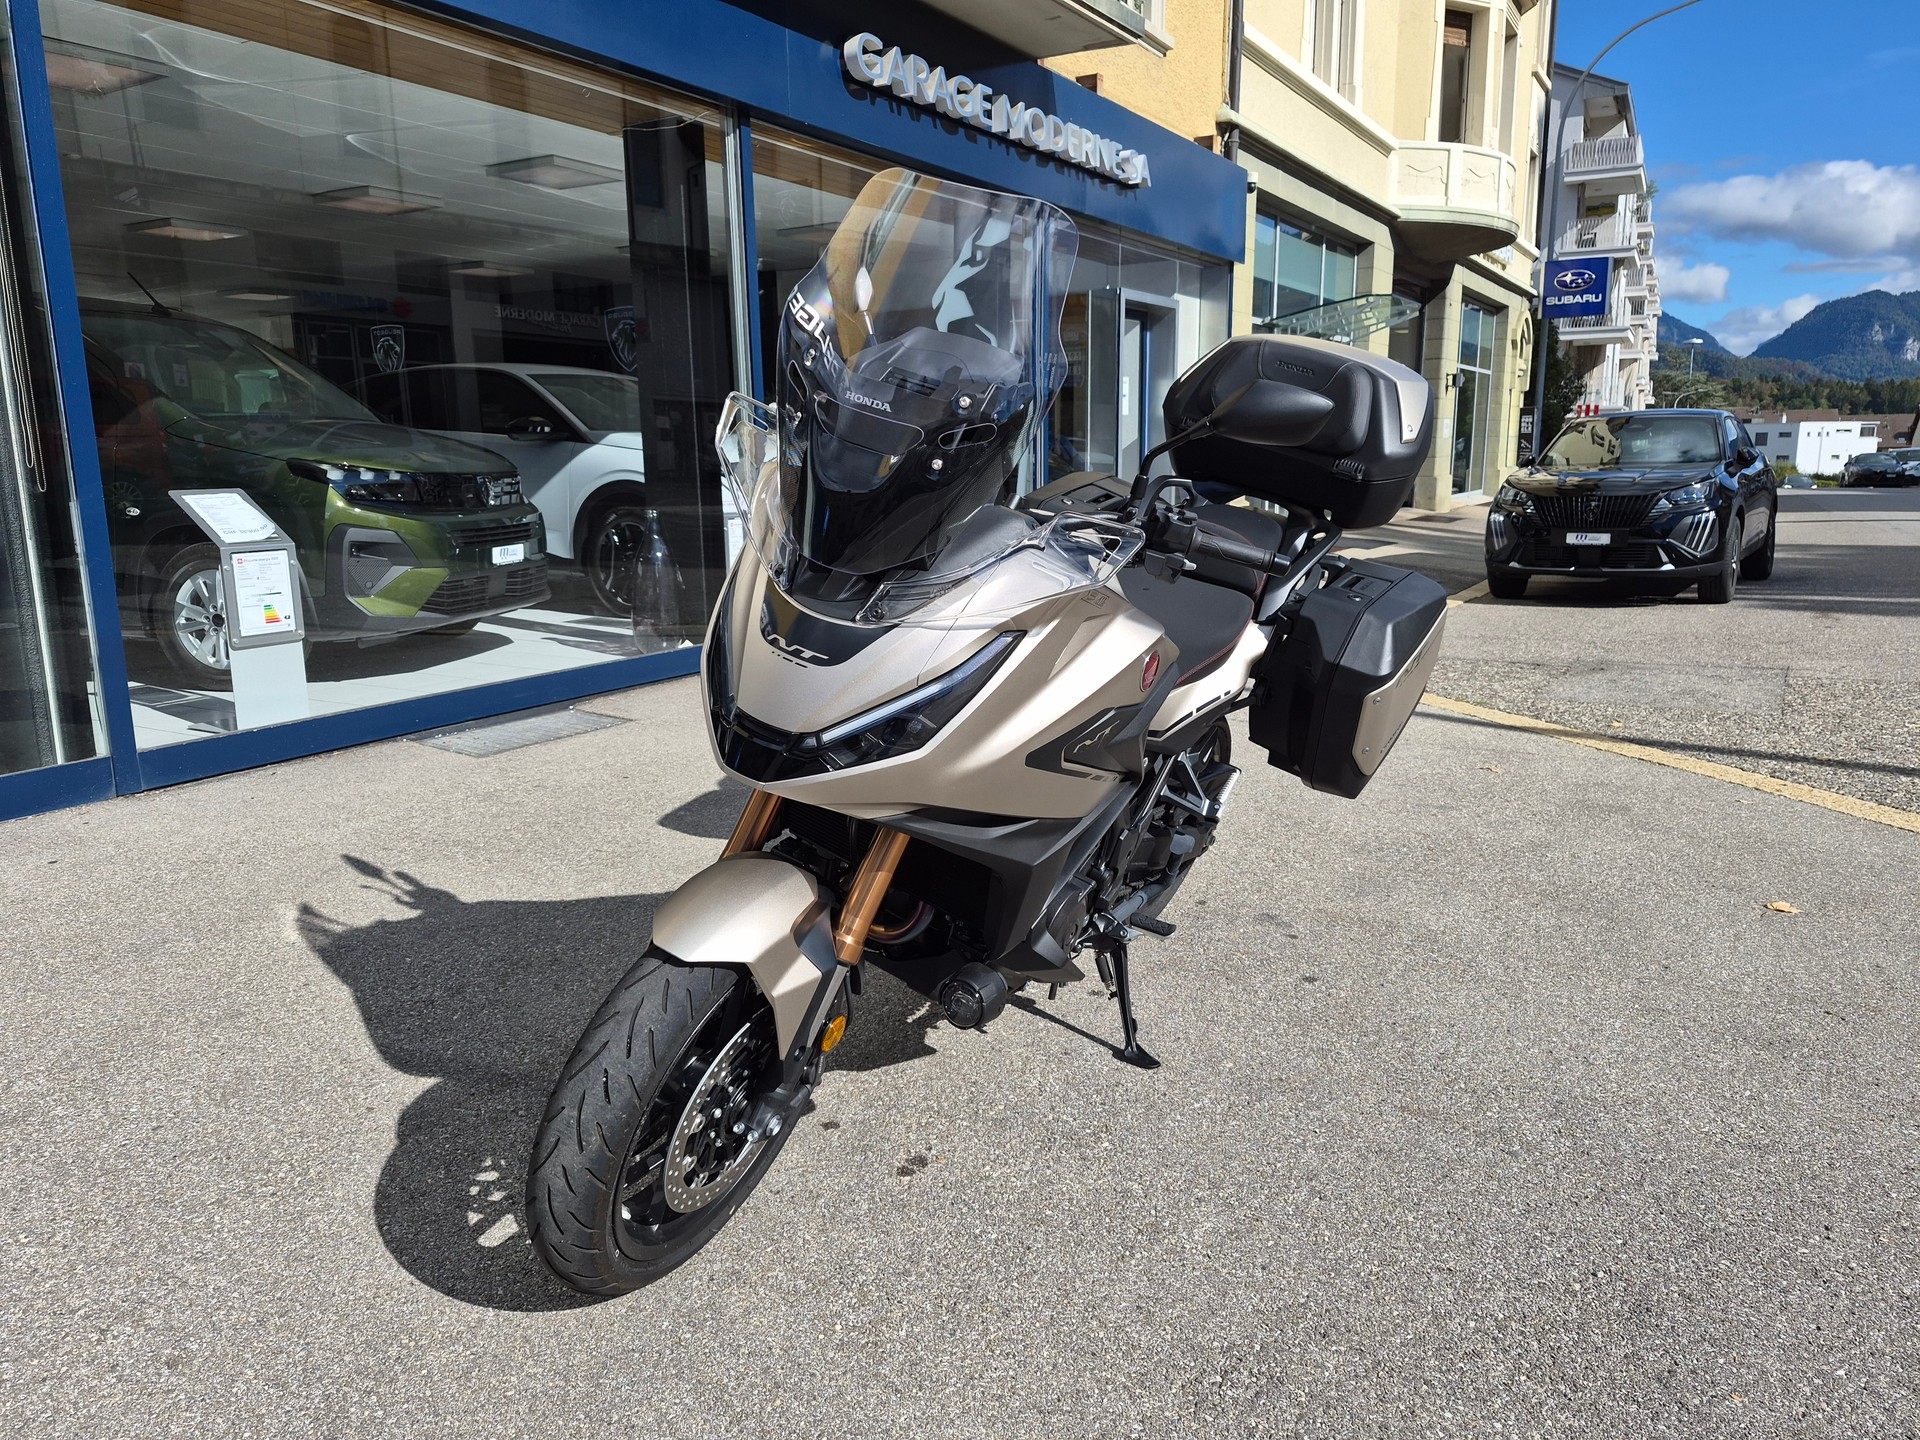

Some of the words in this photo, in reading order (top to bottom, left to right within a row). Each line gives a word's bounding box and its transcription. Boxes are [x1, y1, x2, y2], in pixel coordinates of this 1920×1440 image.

[844, 32, 993, 129] GARAGE
[992, 93, 1122, 176] MODERNE
[1118, 149, 1152, 188] SA
[1545, 293, 1602, 306] SUBARU
[844, 391, 893, 413] HONDA
